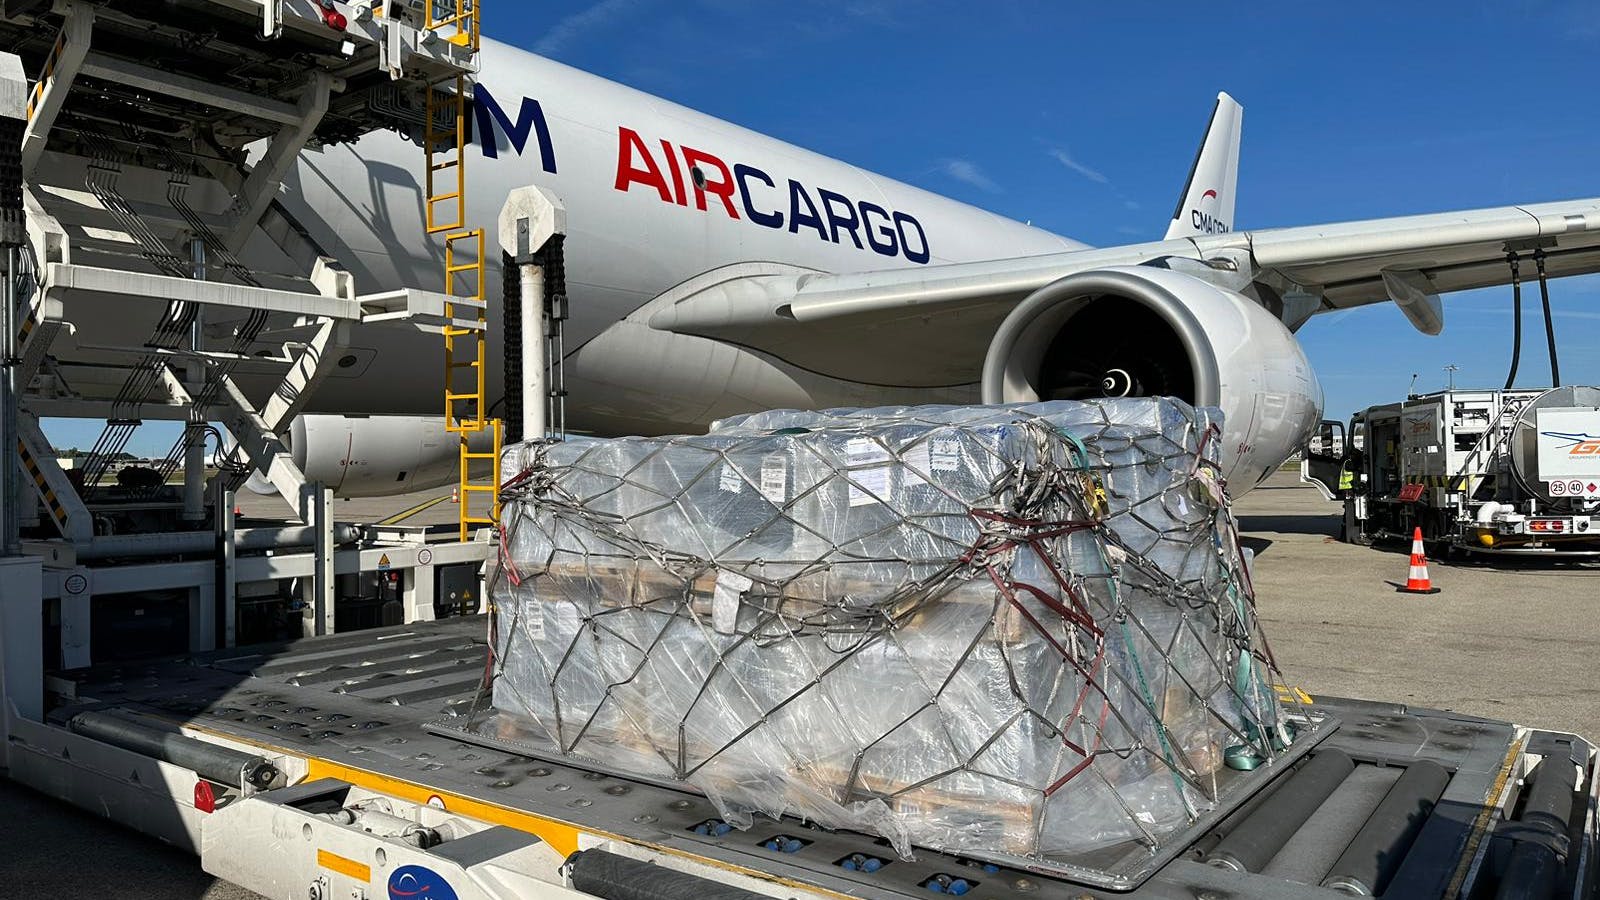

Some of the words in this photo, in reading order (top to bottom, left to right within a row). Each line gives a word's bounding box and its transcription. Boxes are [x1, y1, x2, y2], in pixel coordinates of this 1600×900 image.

[614, 126, 931, 265] AIRCARGO
[1192, 209, 1213, 234] CMA
[1553, 483, 1563, 492] 25
[1571, 483, 1581, 492] 40
